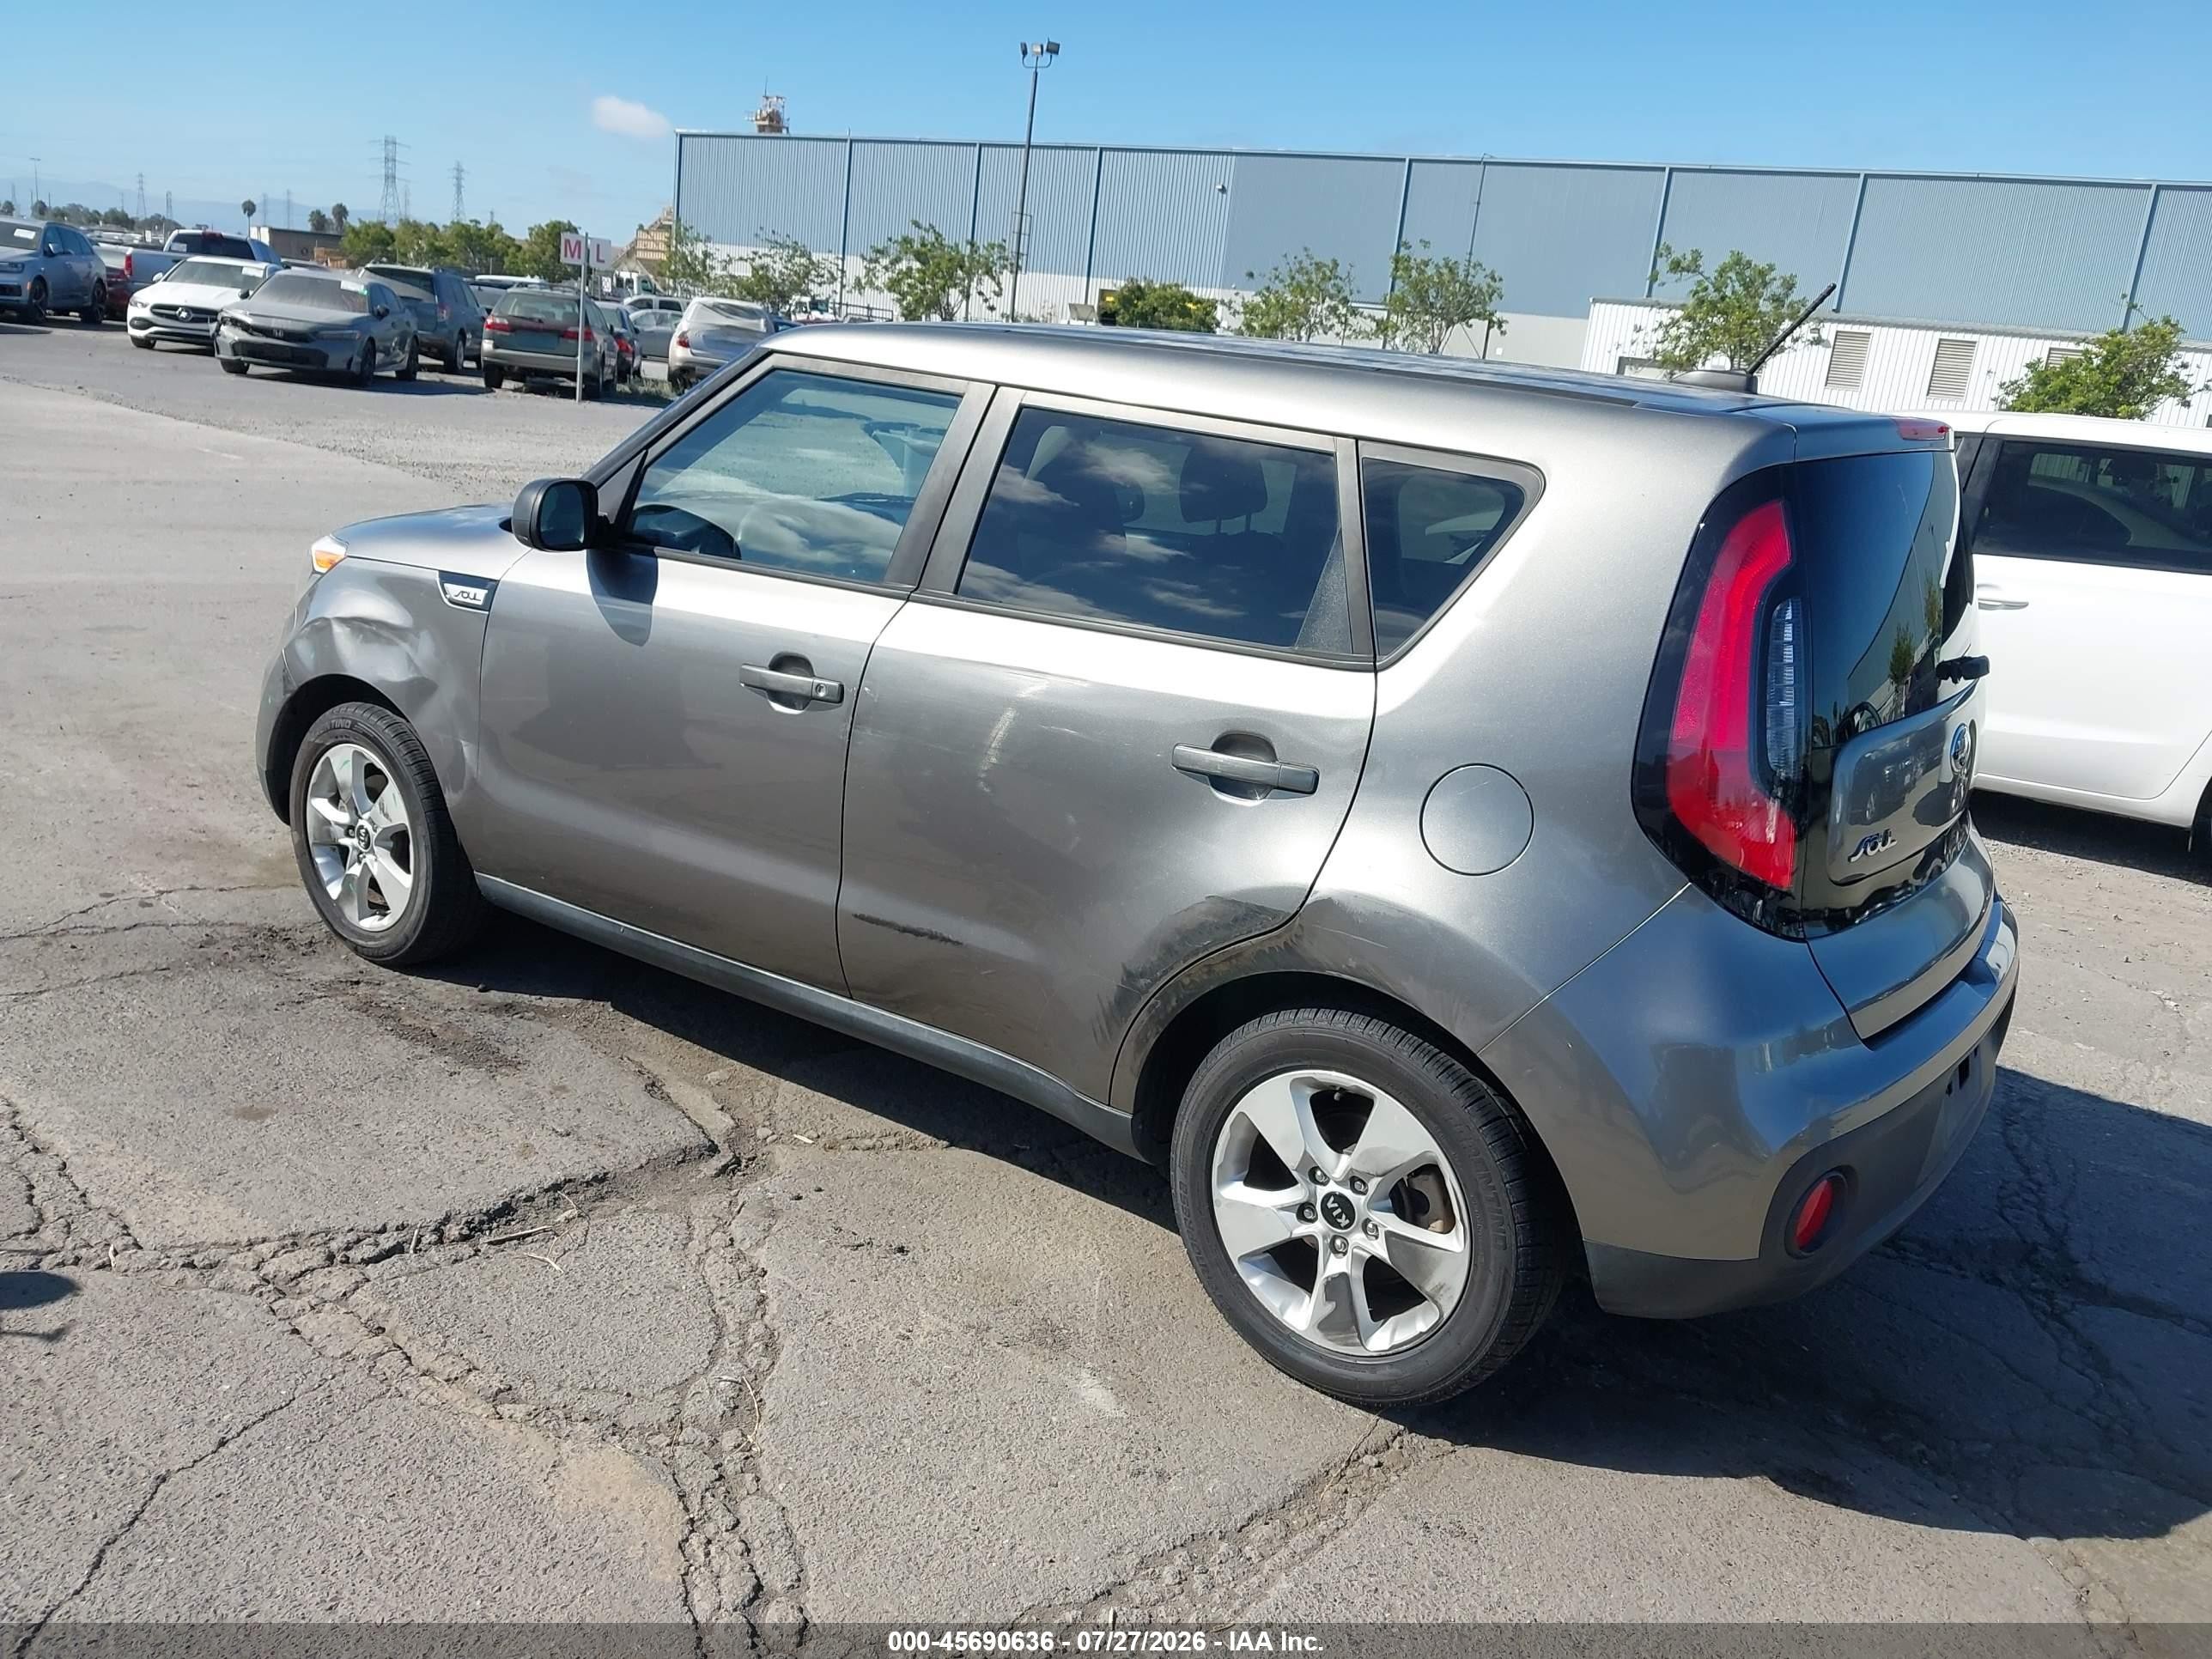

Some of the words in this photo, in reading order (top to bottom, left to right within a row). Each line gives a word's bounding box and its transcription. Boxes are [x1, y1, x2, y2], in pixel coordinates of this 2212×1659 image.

[563, 239, 582, 259] M
[596, 244, 605, 264] L
[1327, 1194, 1351, 1229] KIA
